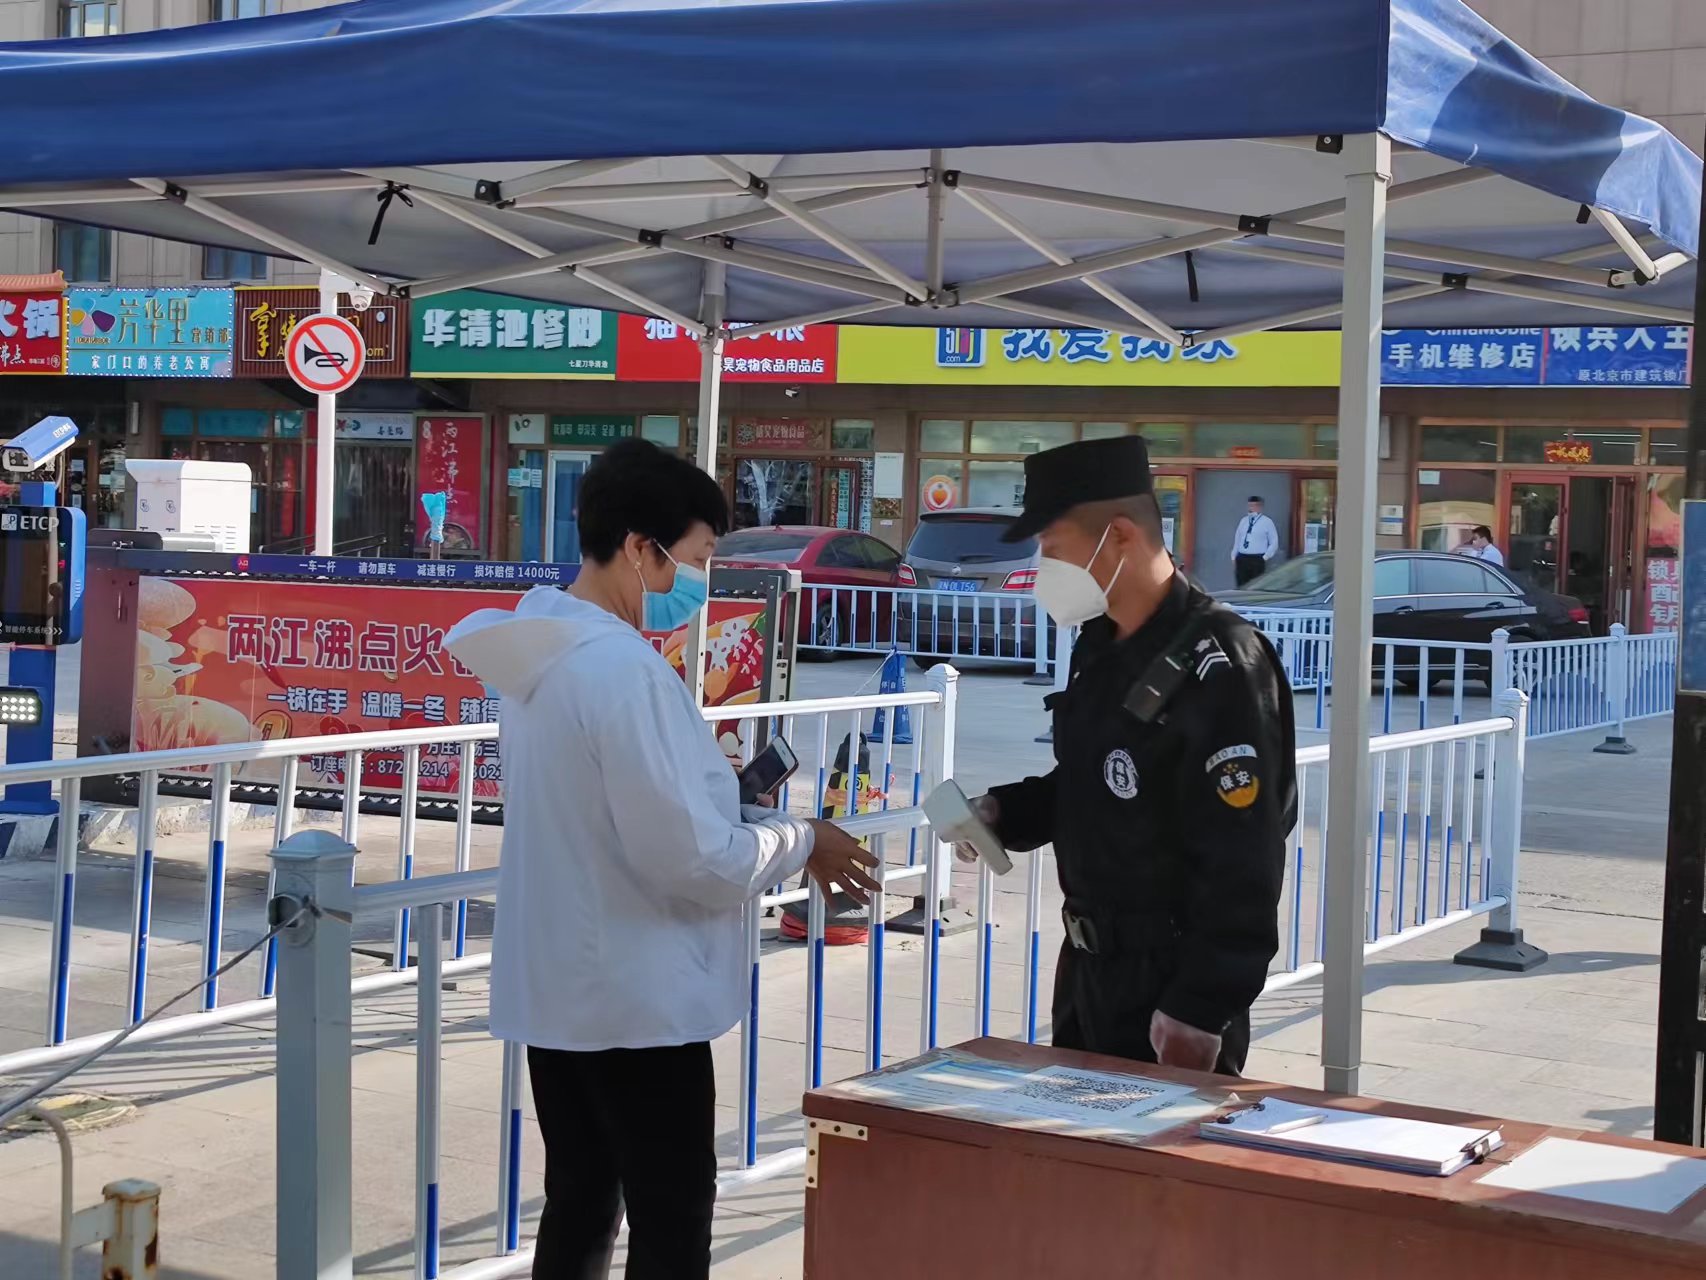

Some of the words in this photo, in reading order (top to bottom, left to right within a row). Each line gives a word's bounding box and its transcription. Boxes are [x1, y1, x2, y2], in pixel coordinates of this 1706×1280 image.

[118, 298, 188, 344] 芳华里
[91, 354, 210, 371] 家门口的养老公寓
[1388, 343, 1536, 369] 手机维修店
[20, 515, 60, 532] ETCP
[299, 560, 336, 572] 一车一杆
[358, 561, 397, 576] 请勿跟车
[416, 564, 456, 577] 减速慢行
[474, 565, 514, 579] 损坏赔偿
[517, 566, 560, 580] 14000元
[226, 614, 474, 677] 两江沸点火
[267, 687, 347, 714] 一锅在手
[361, 692, 445, 721] 温暖一冬
[1220, 770, 1250, 790] 保安
